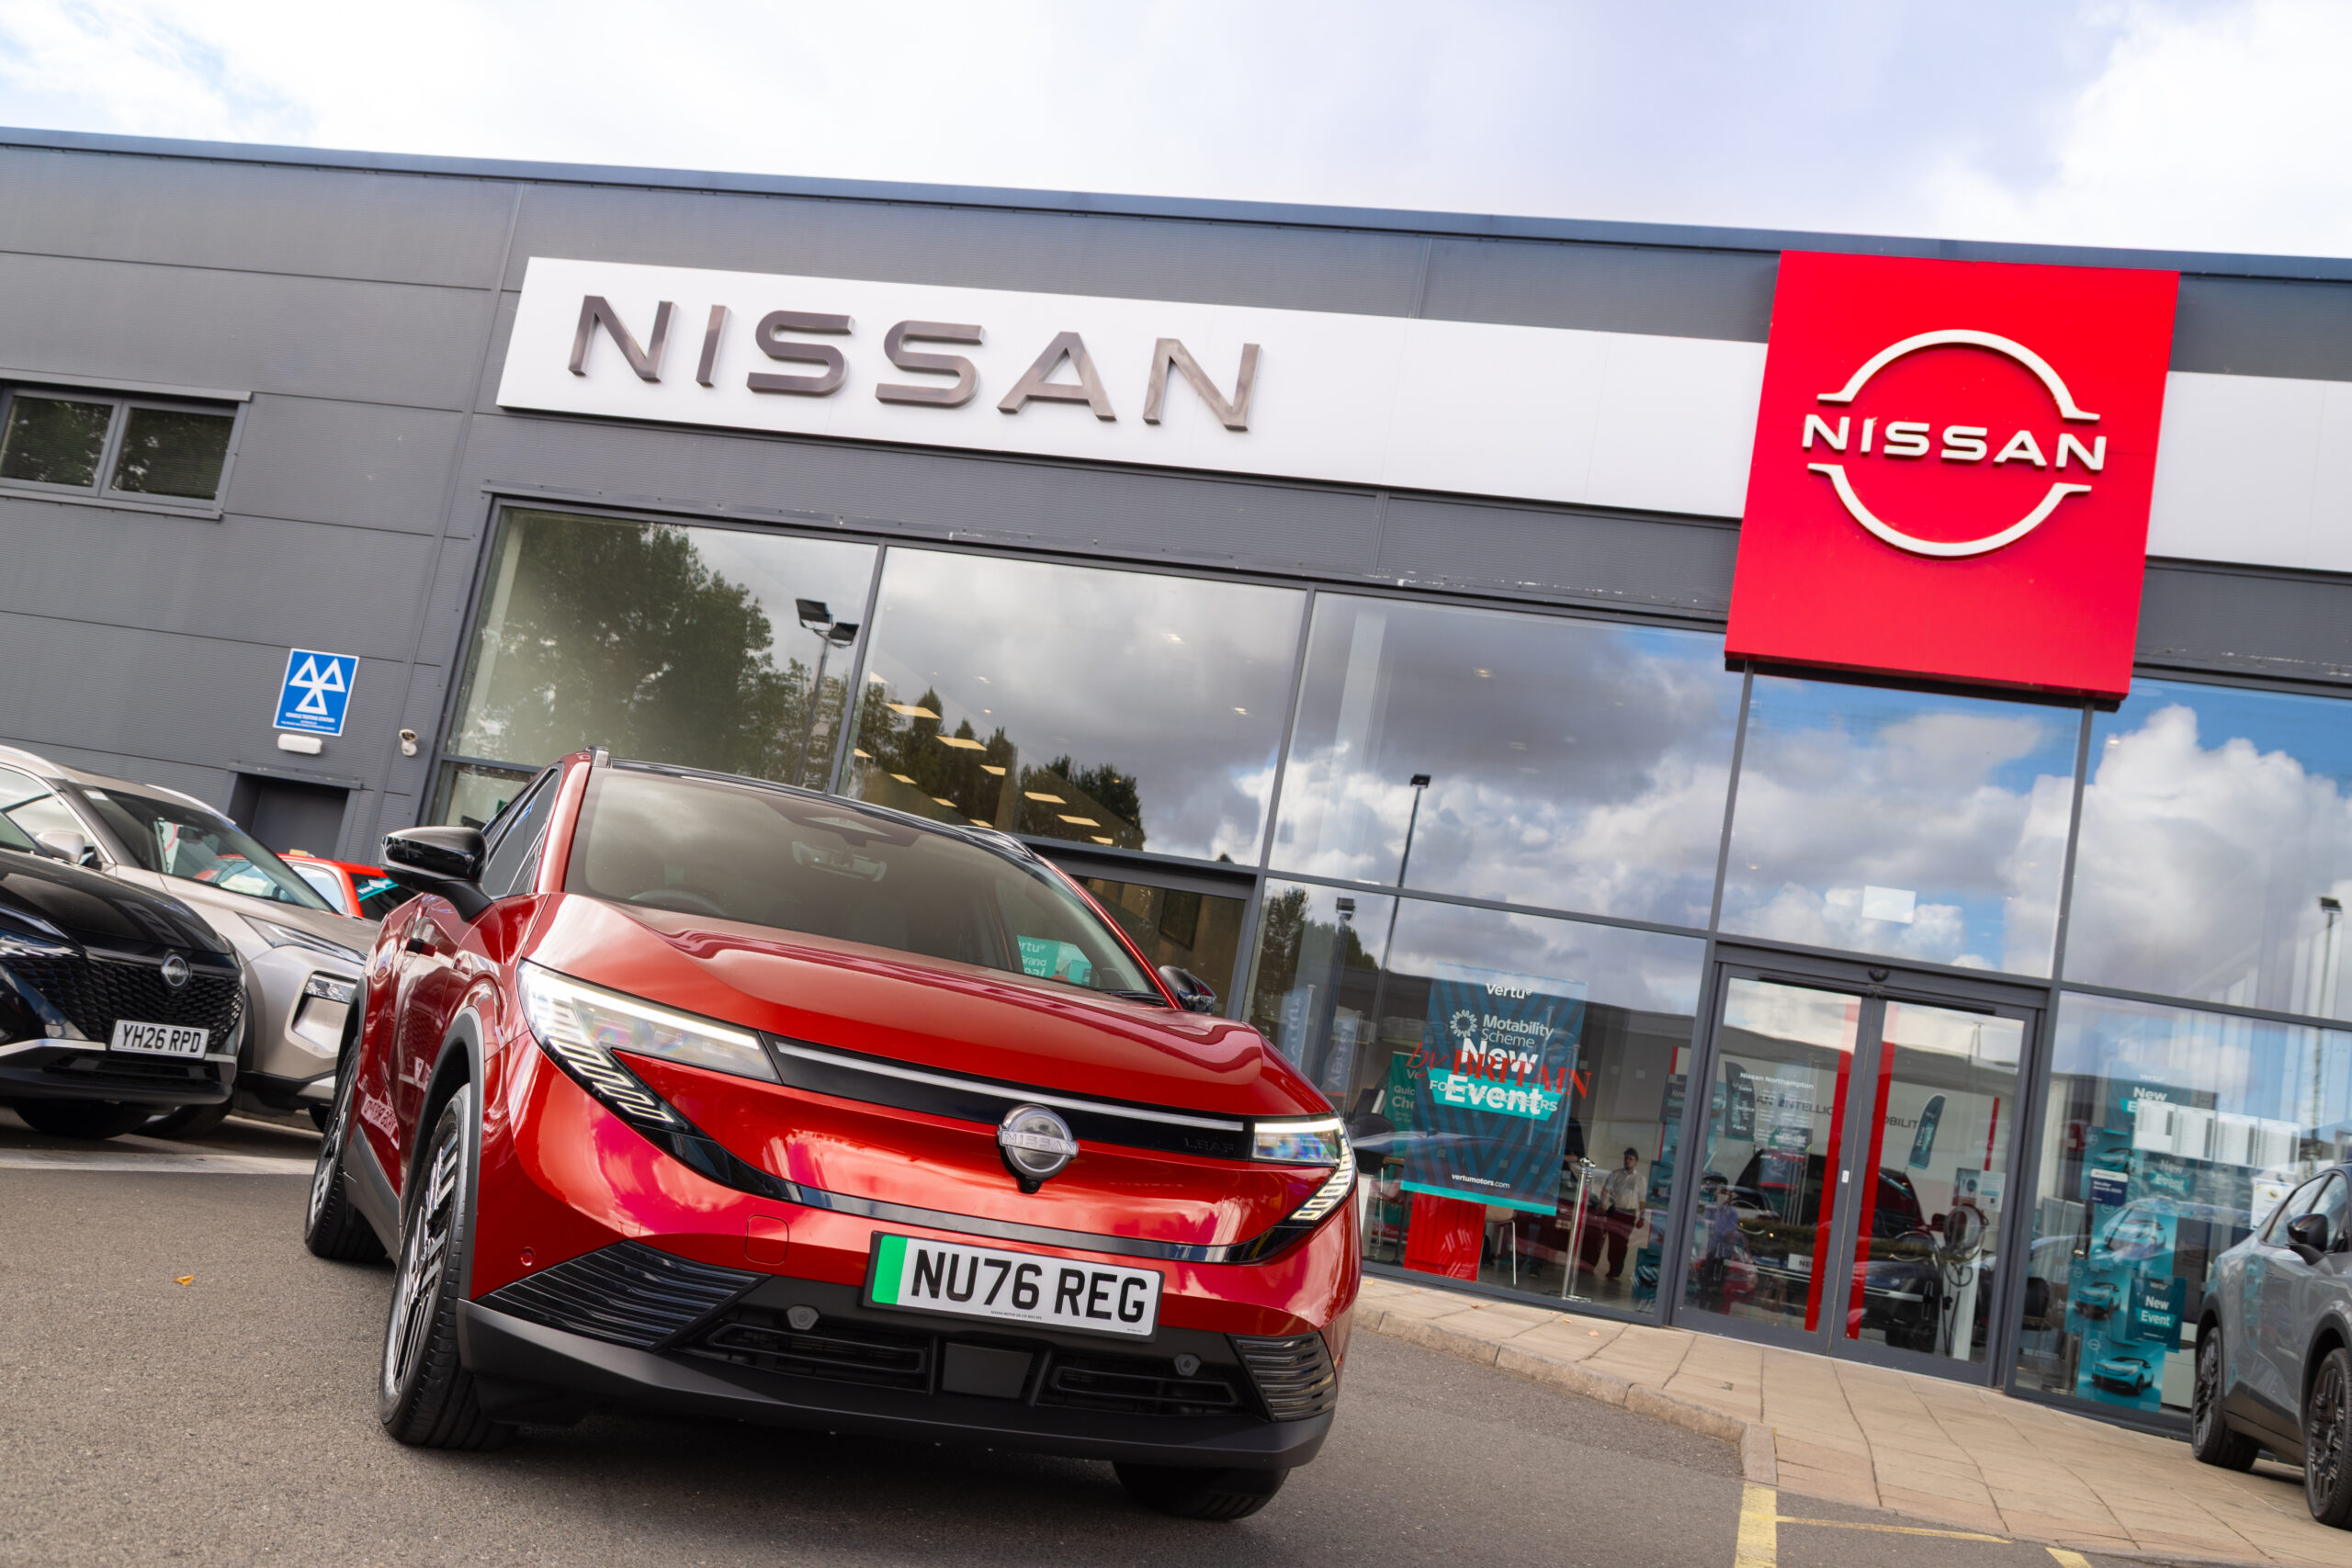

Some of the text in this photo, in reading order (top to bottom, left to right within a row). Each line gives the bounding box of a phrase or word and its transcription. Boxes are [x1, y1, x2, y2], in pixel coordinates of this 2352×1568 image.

[568, 294, 1261, 432] NISSAN
[1802, 413, 2107, 471] NISSAN
[1486, 983, 1526, 999] Vertu
[1482, 1014, 1555, 1041] Motability
[122, 1023, 201, 1053] YH26 RPD
[1481, 1028, 1535, 1048] Scheme
[1462, 1037, 1539, 1075] New
[1406, 1041, 1592, 1100] by BRITAIN
[1394, 1085, 1416, 1096] Quic
[1739, 1072, 1815, 1090] Nissan Northampton
[1445, 1074, 1544, 1115] Event
[2133, 1086, 2168, 1101] New
[1884, 1115, 1918, 1129] OBILIT
[1003, 1131, 1077, 1156] NISSAN
[1452, 1173, 1510, 1189] vertumotors.com
[1799, 1259, 1811, 1268] NE
[910, 1248, 1148, 1324] NU76 REG
[2145, 1295, 2170, 1311] New
[2141, 1310, 2170, 1326] Event
